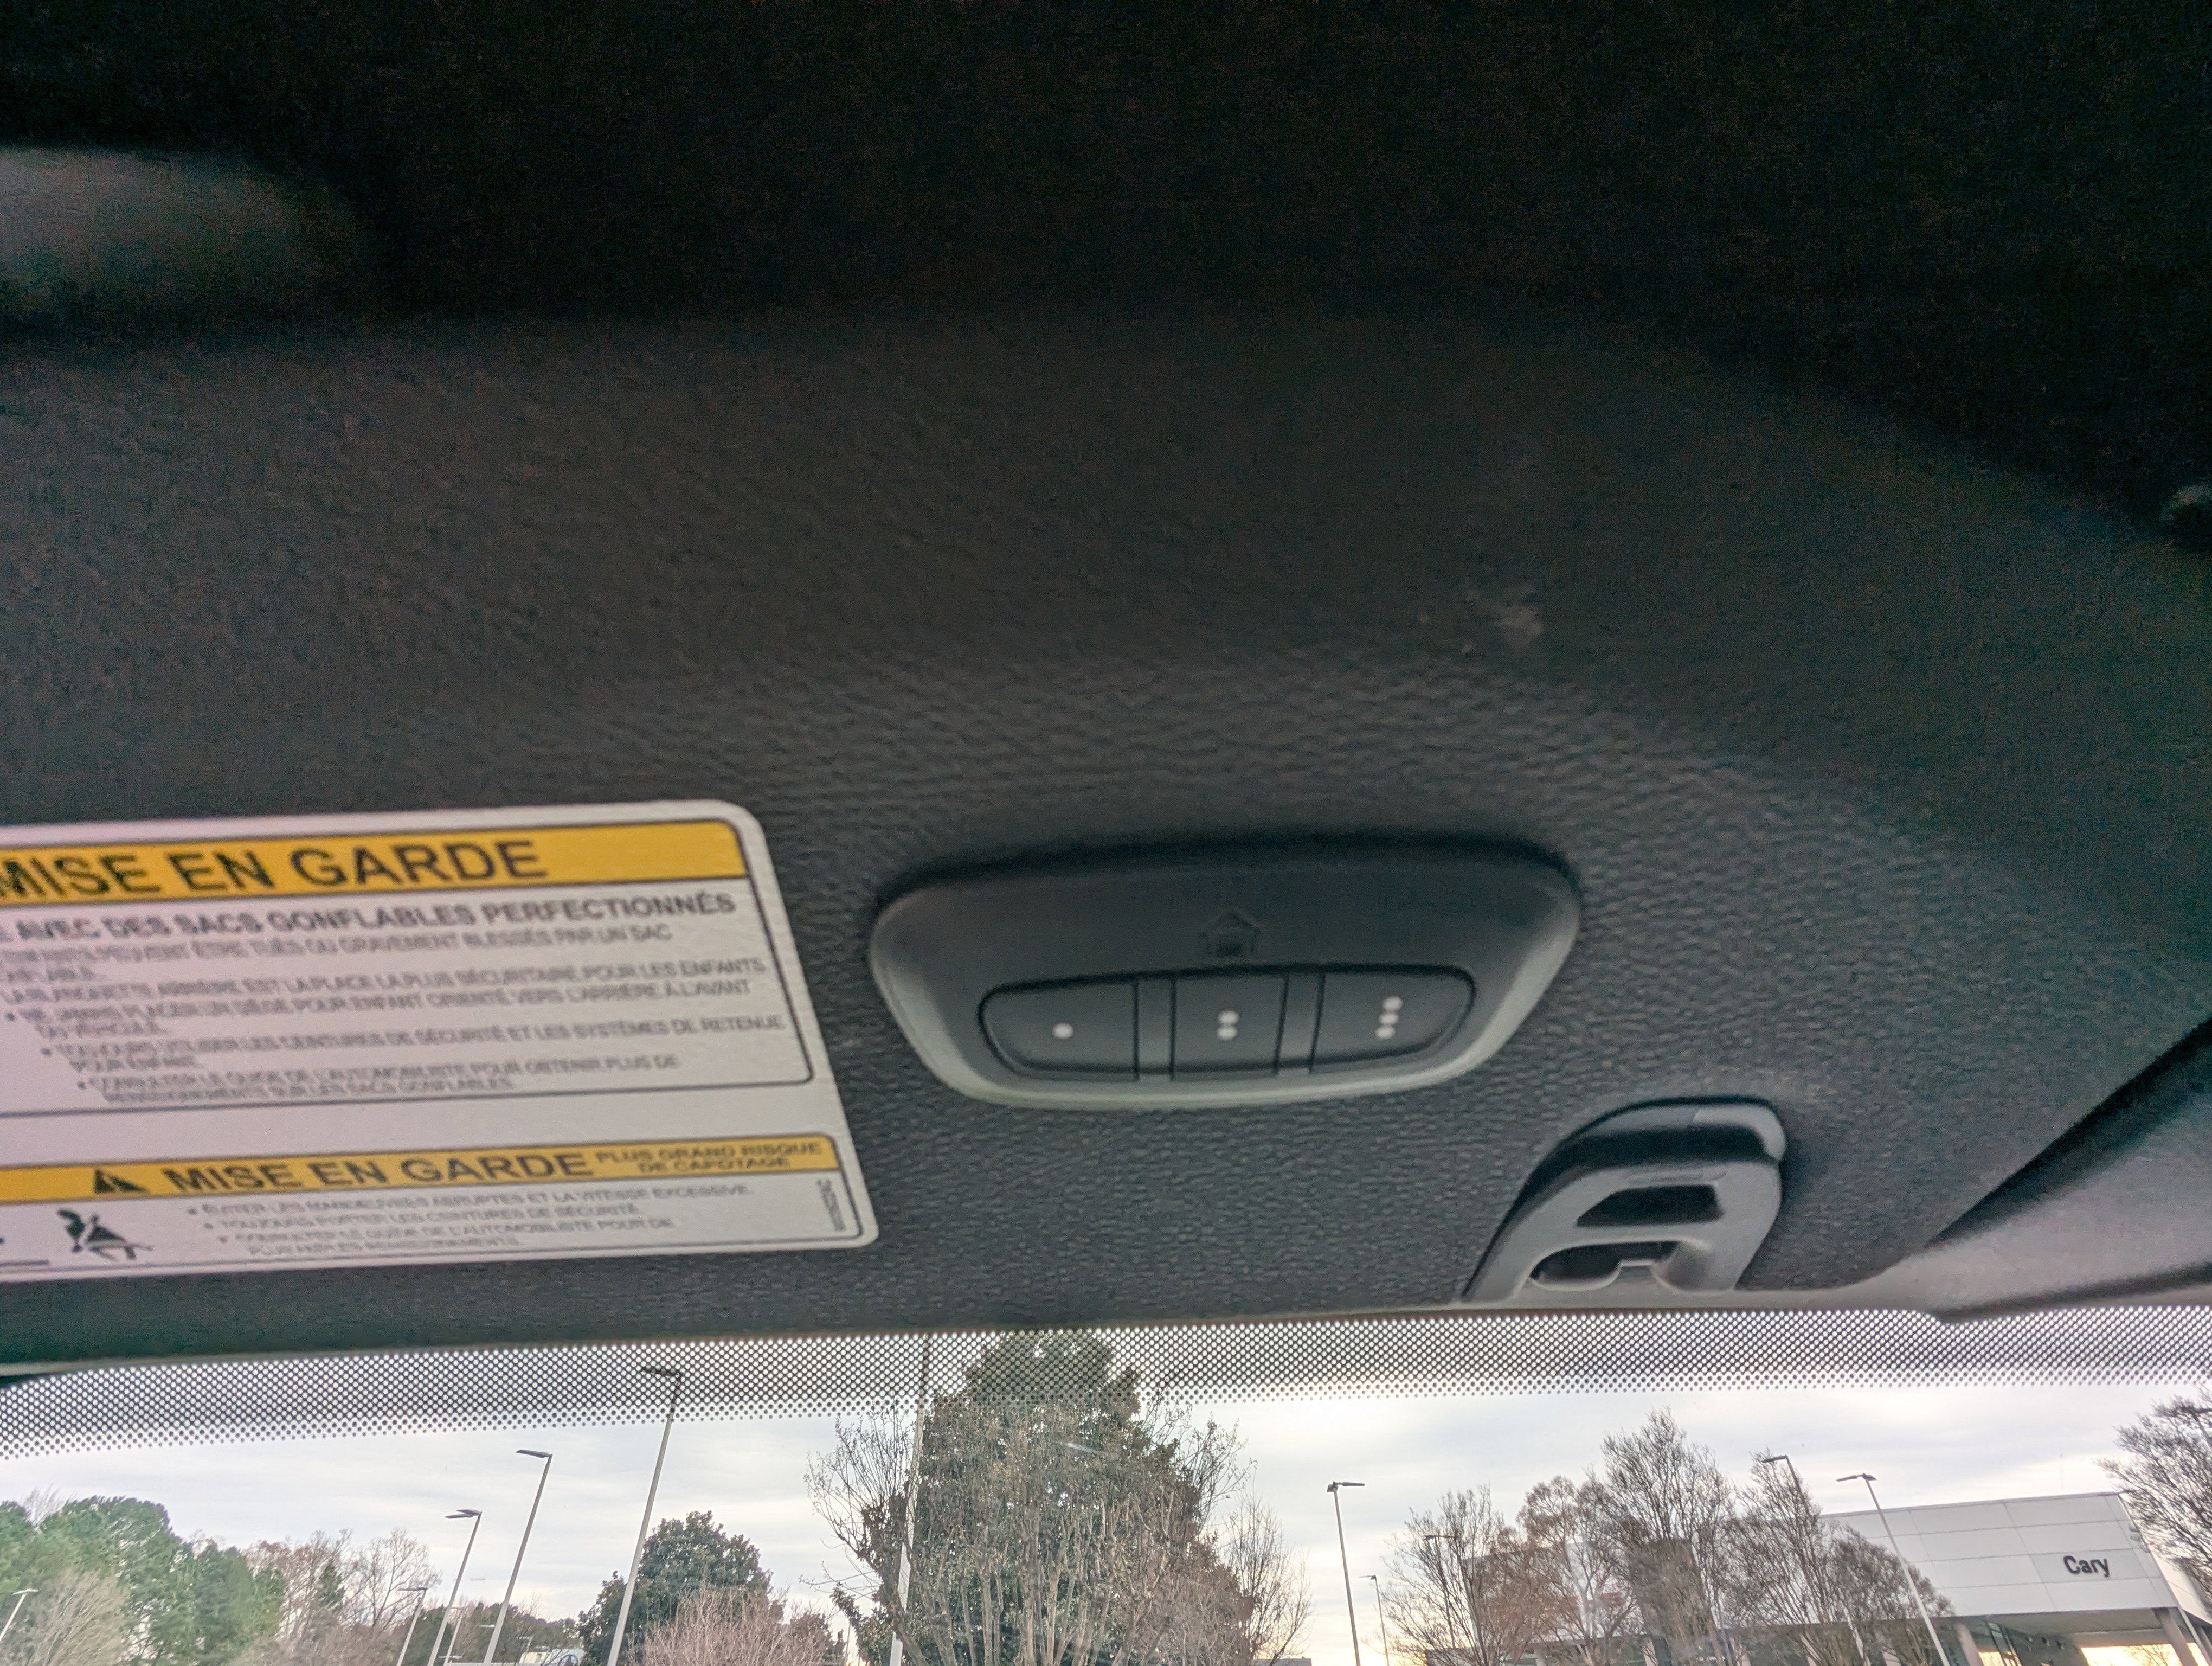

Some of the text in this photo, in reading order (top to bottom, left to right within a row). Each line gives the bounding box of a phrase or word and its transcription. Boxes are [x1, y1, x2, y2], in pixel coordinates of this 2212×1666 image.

[166, 849, 275, 890] EN
[290, 841, 549, 886] GARDE
[173, 913, 262, 933] SACS
[267, 904, 475, 931] GONFLABLES
[480, 890, 736, 922] PERFECTIONNÉS
[629, 923, 672, 941] SAC
[671, 1019, 697, 1034] DE
[163, 1142, 822, 1192] MISE EN GARDE PLUS GRAND RISQUE
[2063, 1555, 2110, 1578] Cary
